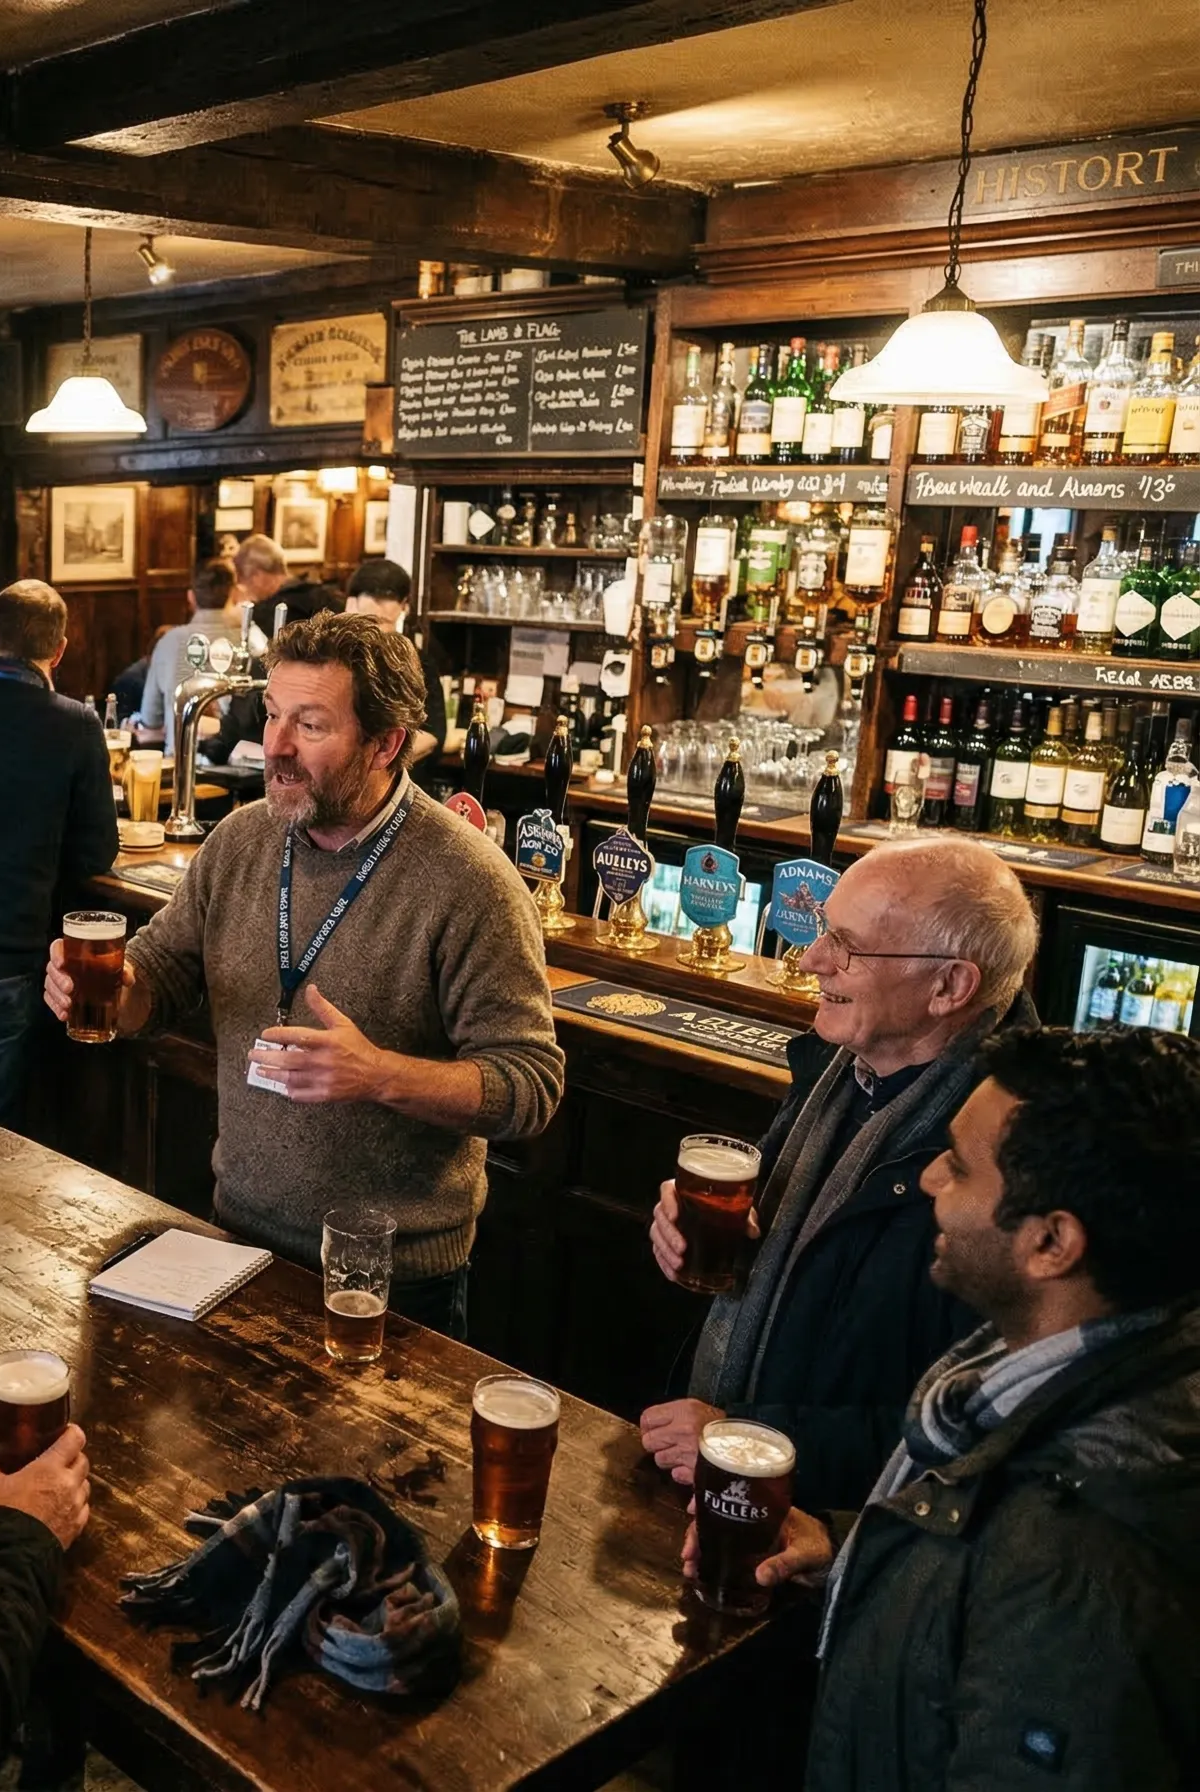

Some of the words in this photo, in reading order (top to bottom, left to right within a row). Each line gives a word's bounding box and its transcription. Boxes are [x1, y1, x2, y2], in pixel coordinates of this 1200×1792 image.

[971, 146, 1179, 205] HISTORT
[527, 322, 562, 339] FLAG
[1016, 476, 1054, 498] and
[778, 865, 833, 887] ADNAMS
[703, 1489, 769, 1519] FULLERS
